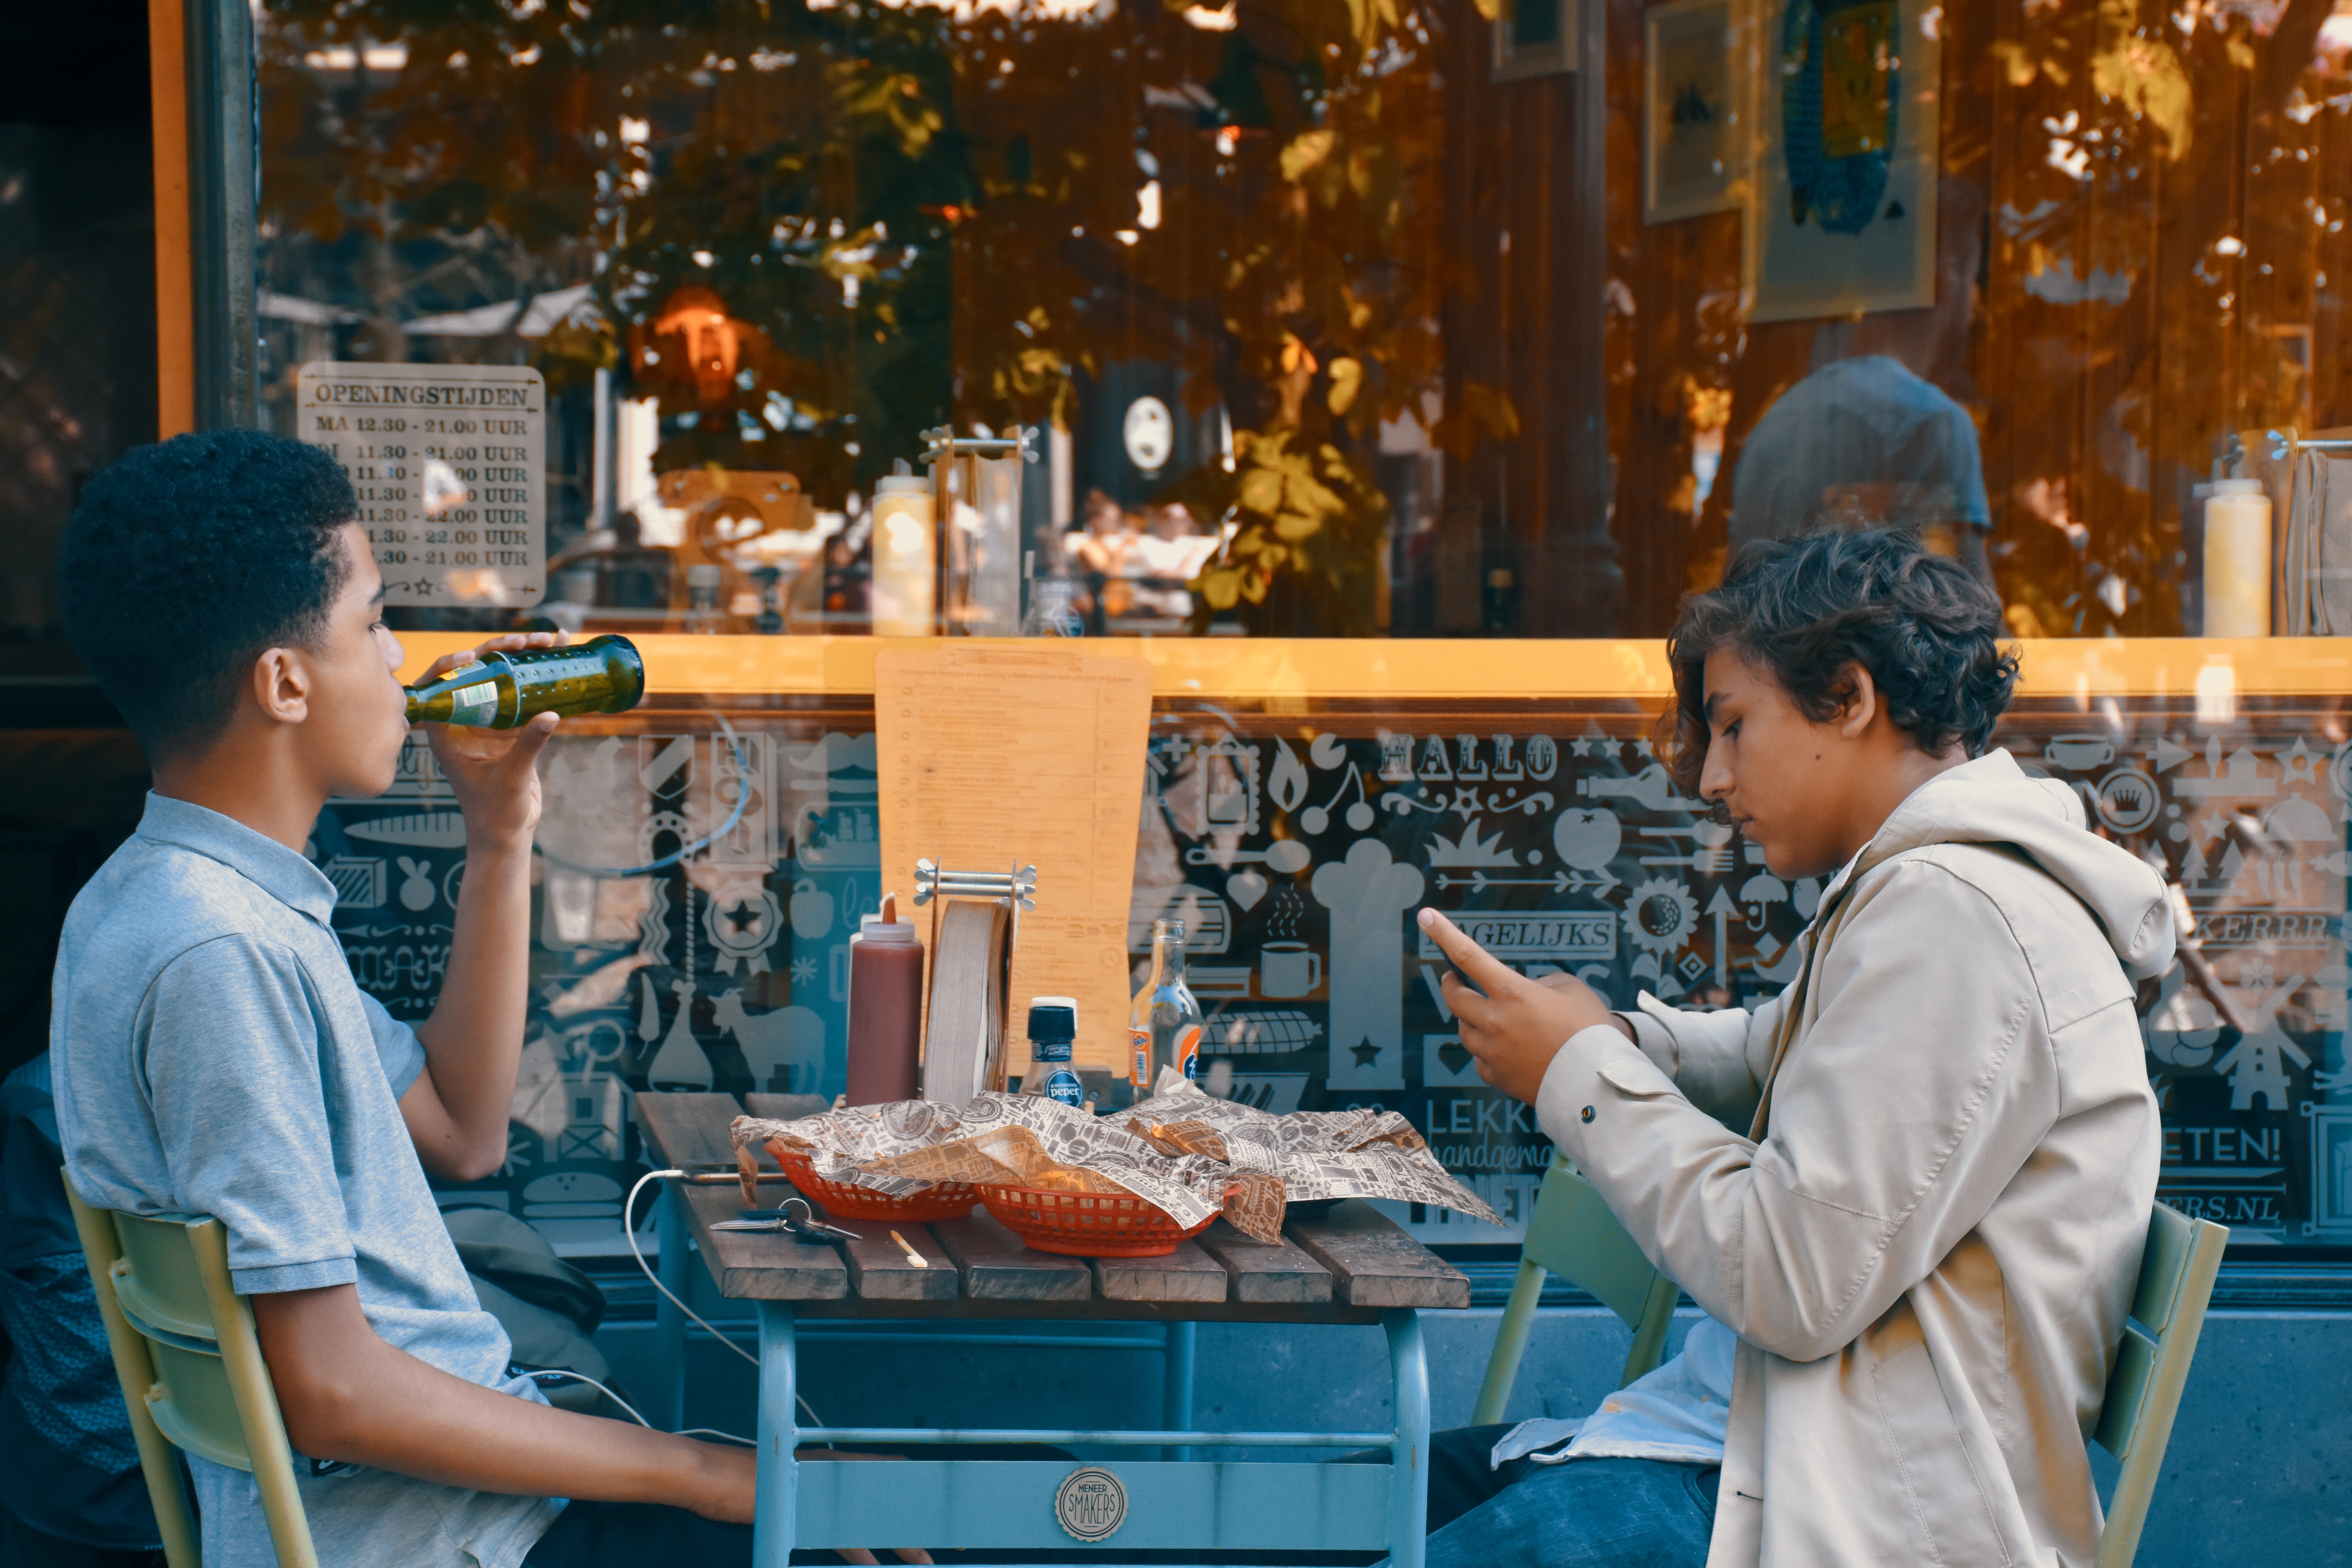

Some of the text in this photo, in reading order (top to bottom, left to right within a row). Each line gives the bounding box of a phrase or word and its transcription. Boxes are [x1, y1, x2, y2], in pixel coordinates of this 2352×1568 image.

[316, 384, 528, 406] OPENINGSTIJDEN
[316, 416, 348, 431] MA
[357, 417, 407, 432] 12.30
[425, 419, 477, 434] 21.00
[484, 419, 528, 435] UUR
[357, 445, 407, 459] 11.30
[484, 446, 528, 461] UUR
[484, 467, 527, 482] UUR
[358, 487, 407, 501] 11.30
[484, 488, 527, 503] UUR
[358, 508, 407, 522] 11.30
[484, 509, 528, 523] UUR
[426, 530, 477, 544] 22.00
[484, 530, 528, 545] UUR
[426, 551, 478, 564] 21.00
[485, 551, 528, 565] UUR
[1377, 733, 1558, 782] HALLO
[1050, 1088, 1080, 1098] peper
[2161, 1127, 2281, 1161] ETEN!
[1078, 1484, 1107, 1493] MENEER
[1068, 1494, 1115, 1524] SMAKERS
